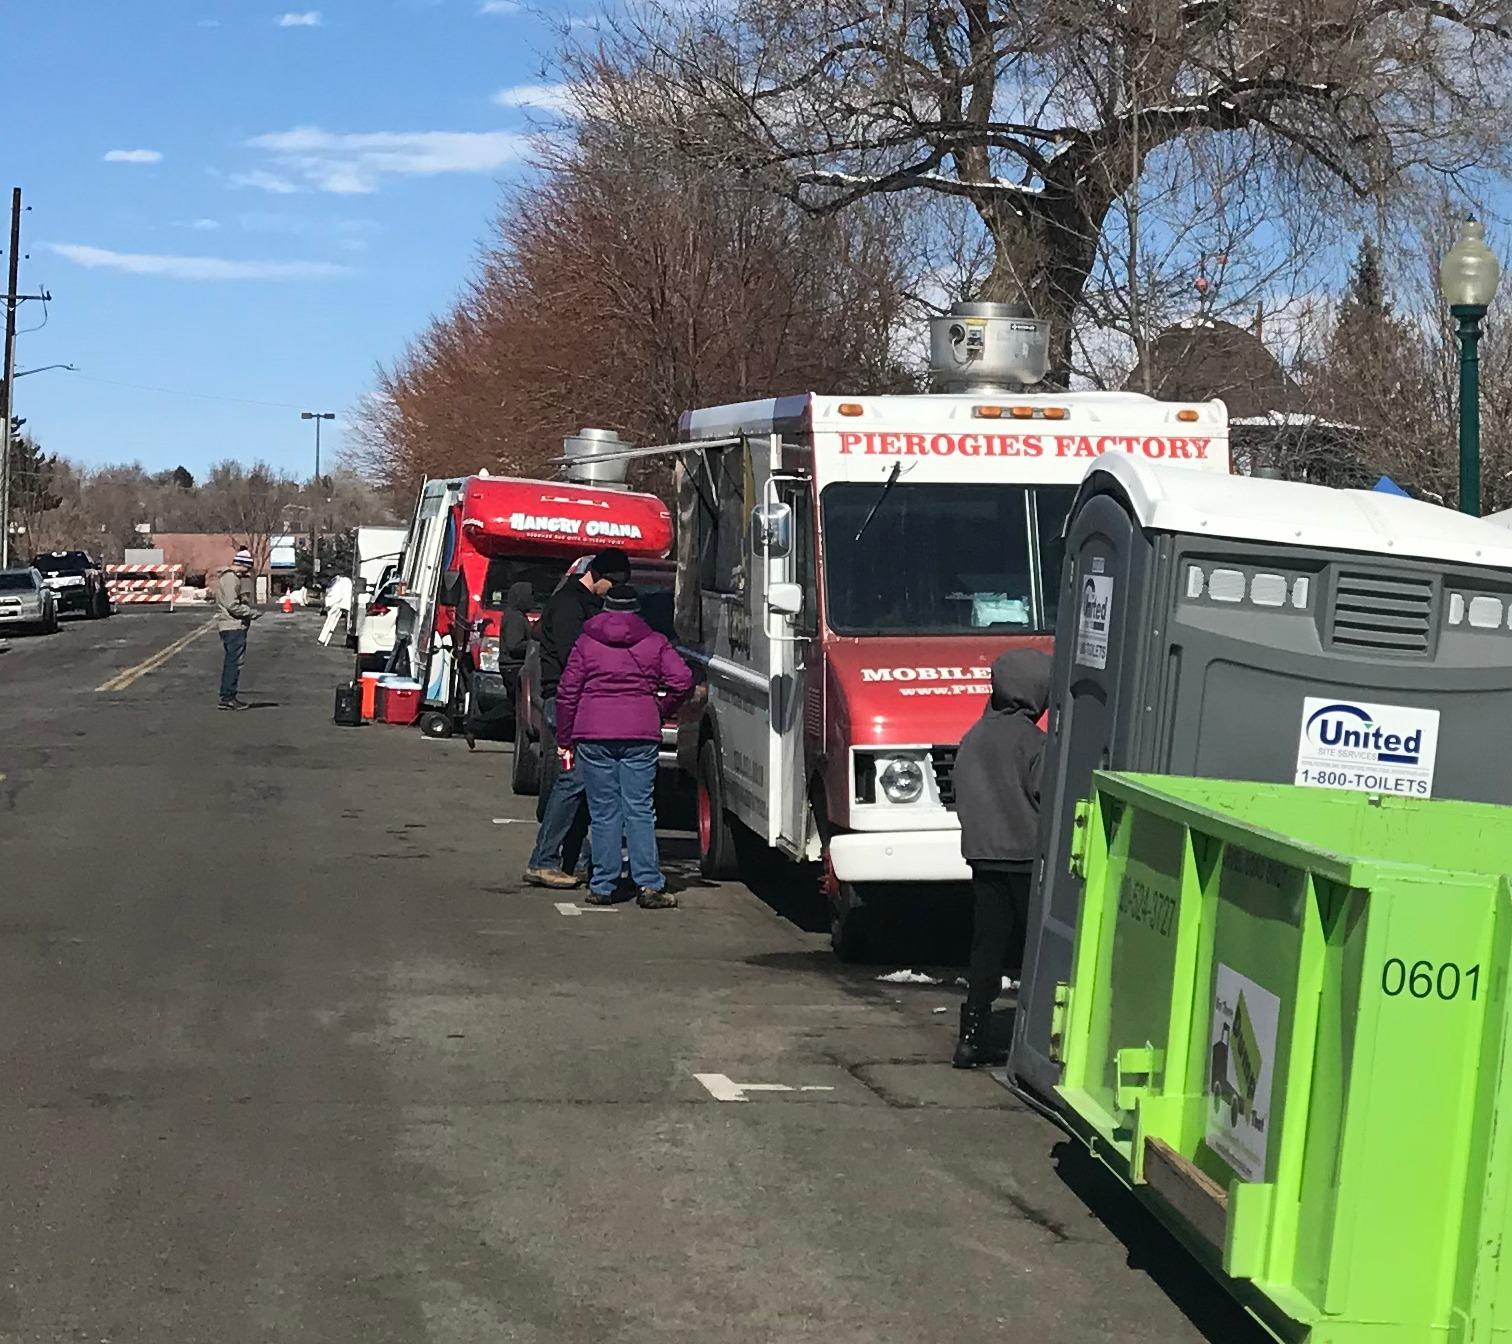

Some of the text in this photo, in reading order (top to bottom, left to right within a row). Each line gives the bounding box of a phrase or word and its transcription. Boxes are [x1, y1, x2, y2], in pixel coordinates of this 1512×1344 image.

[838, 431, 1212, 460] PIEROGIES FACTORY
[510, 511, 583, 535] HANGRY
[585, 519, 643, 539] OHANA
[860, 667, 992, 682] MOBILE
[1319, 719, 1423, 754] United
[1301, 769, 1428, 795] 1-800-TOILETS
[1381, 957, 1480, 1001] 0601
